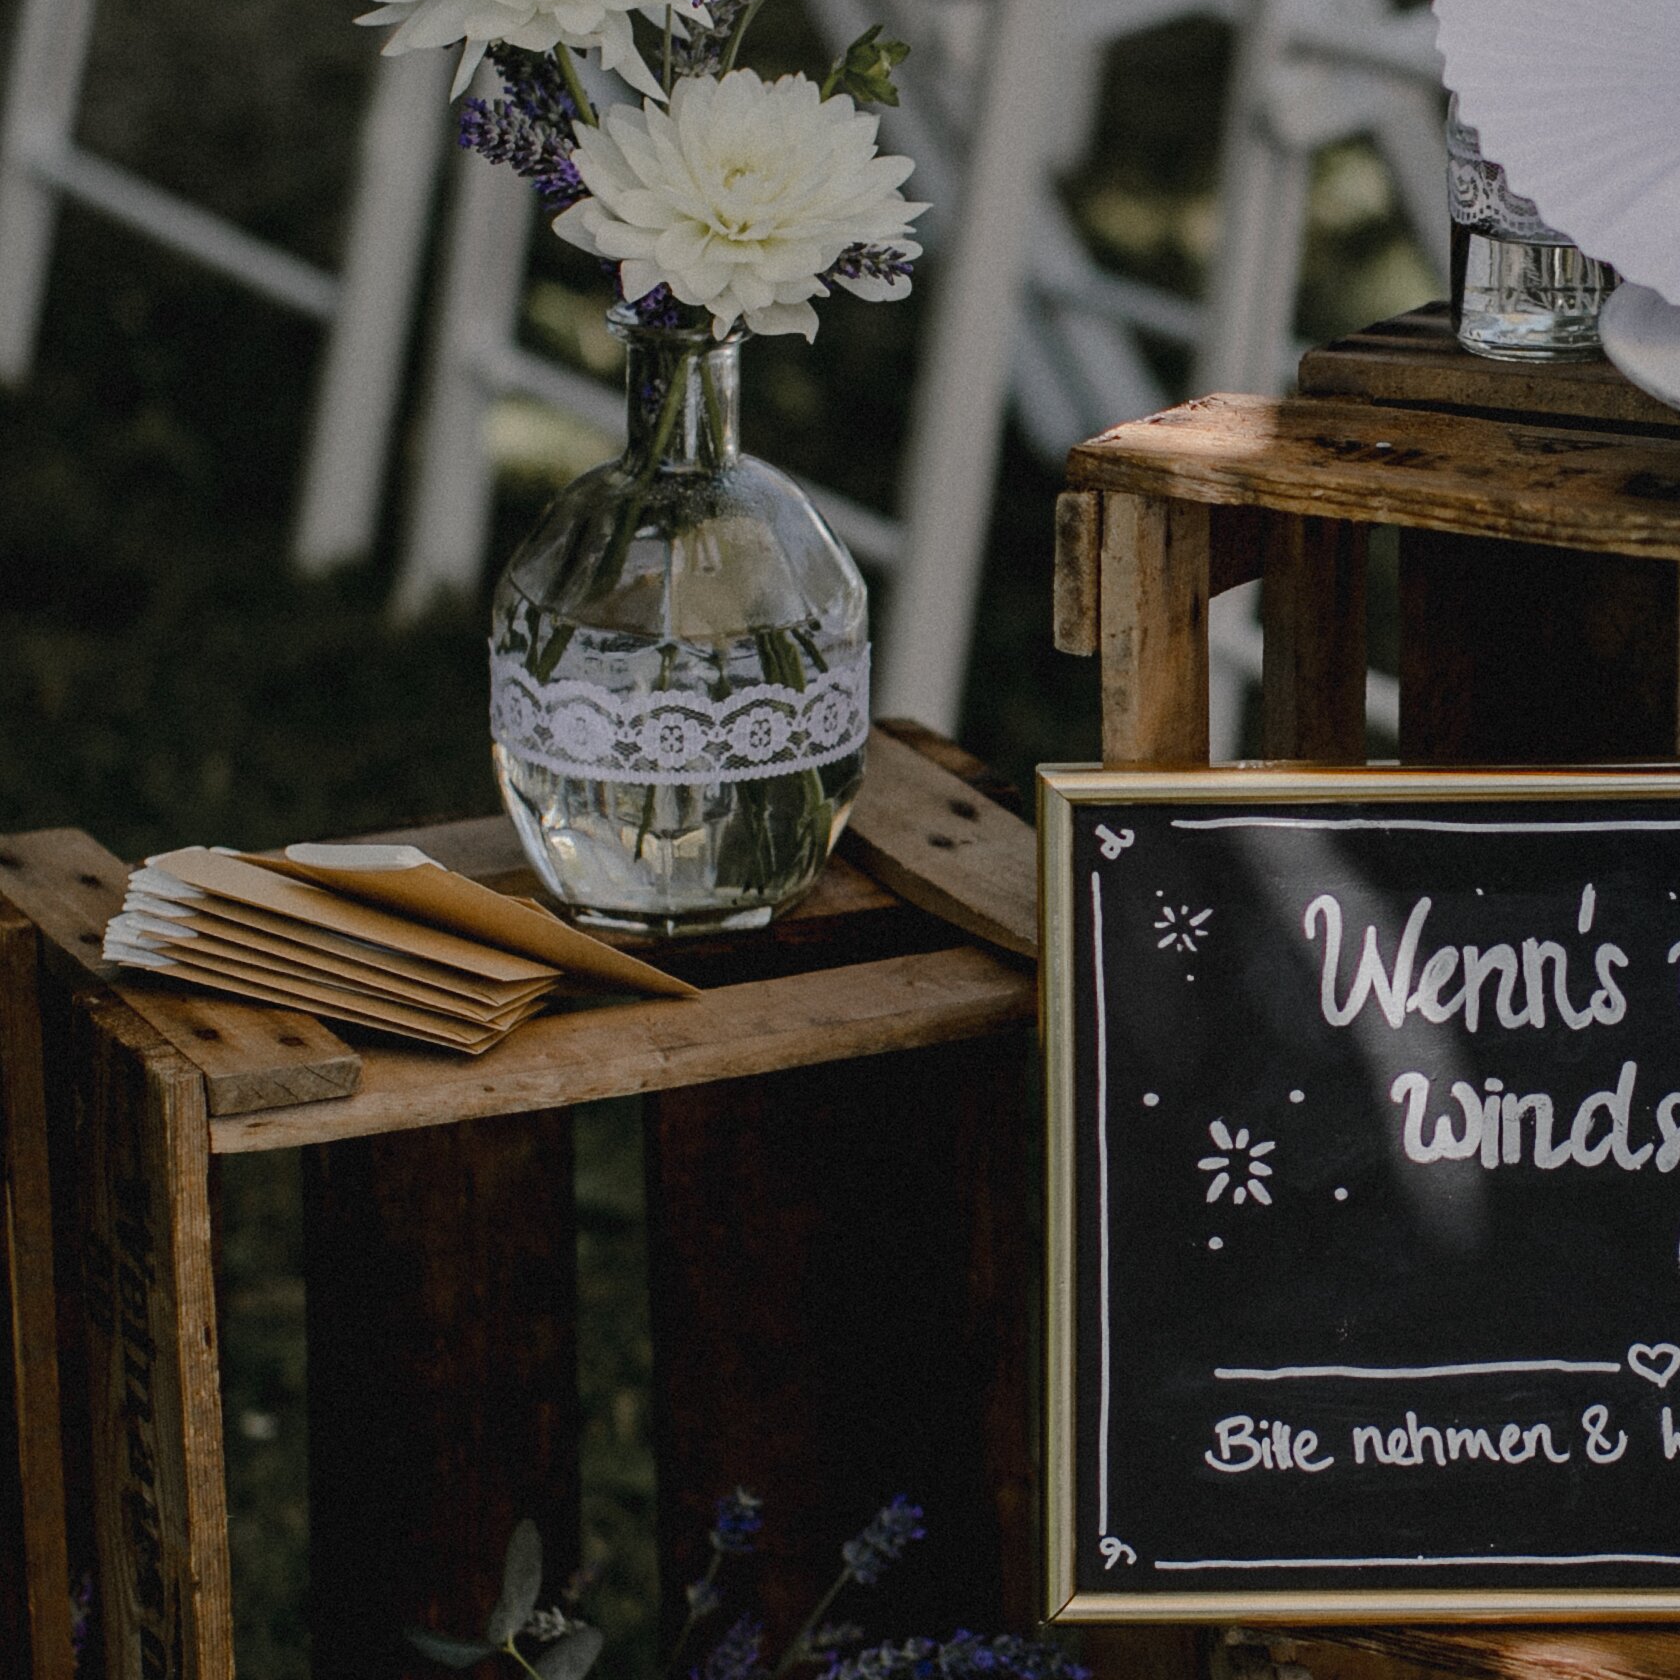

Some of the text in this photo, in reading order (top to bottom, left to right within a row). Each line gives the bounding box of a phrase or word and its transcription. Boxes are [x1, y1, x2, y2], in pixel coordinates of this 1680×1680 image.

[1303, 882, 1629, 1033] Wenn's
[1204, 1414, 1335, 1473] Bitte
[1352, 1410, 1570, 1467] nehmen
[1581, 1403, 1629, 1464] &
